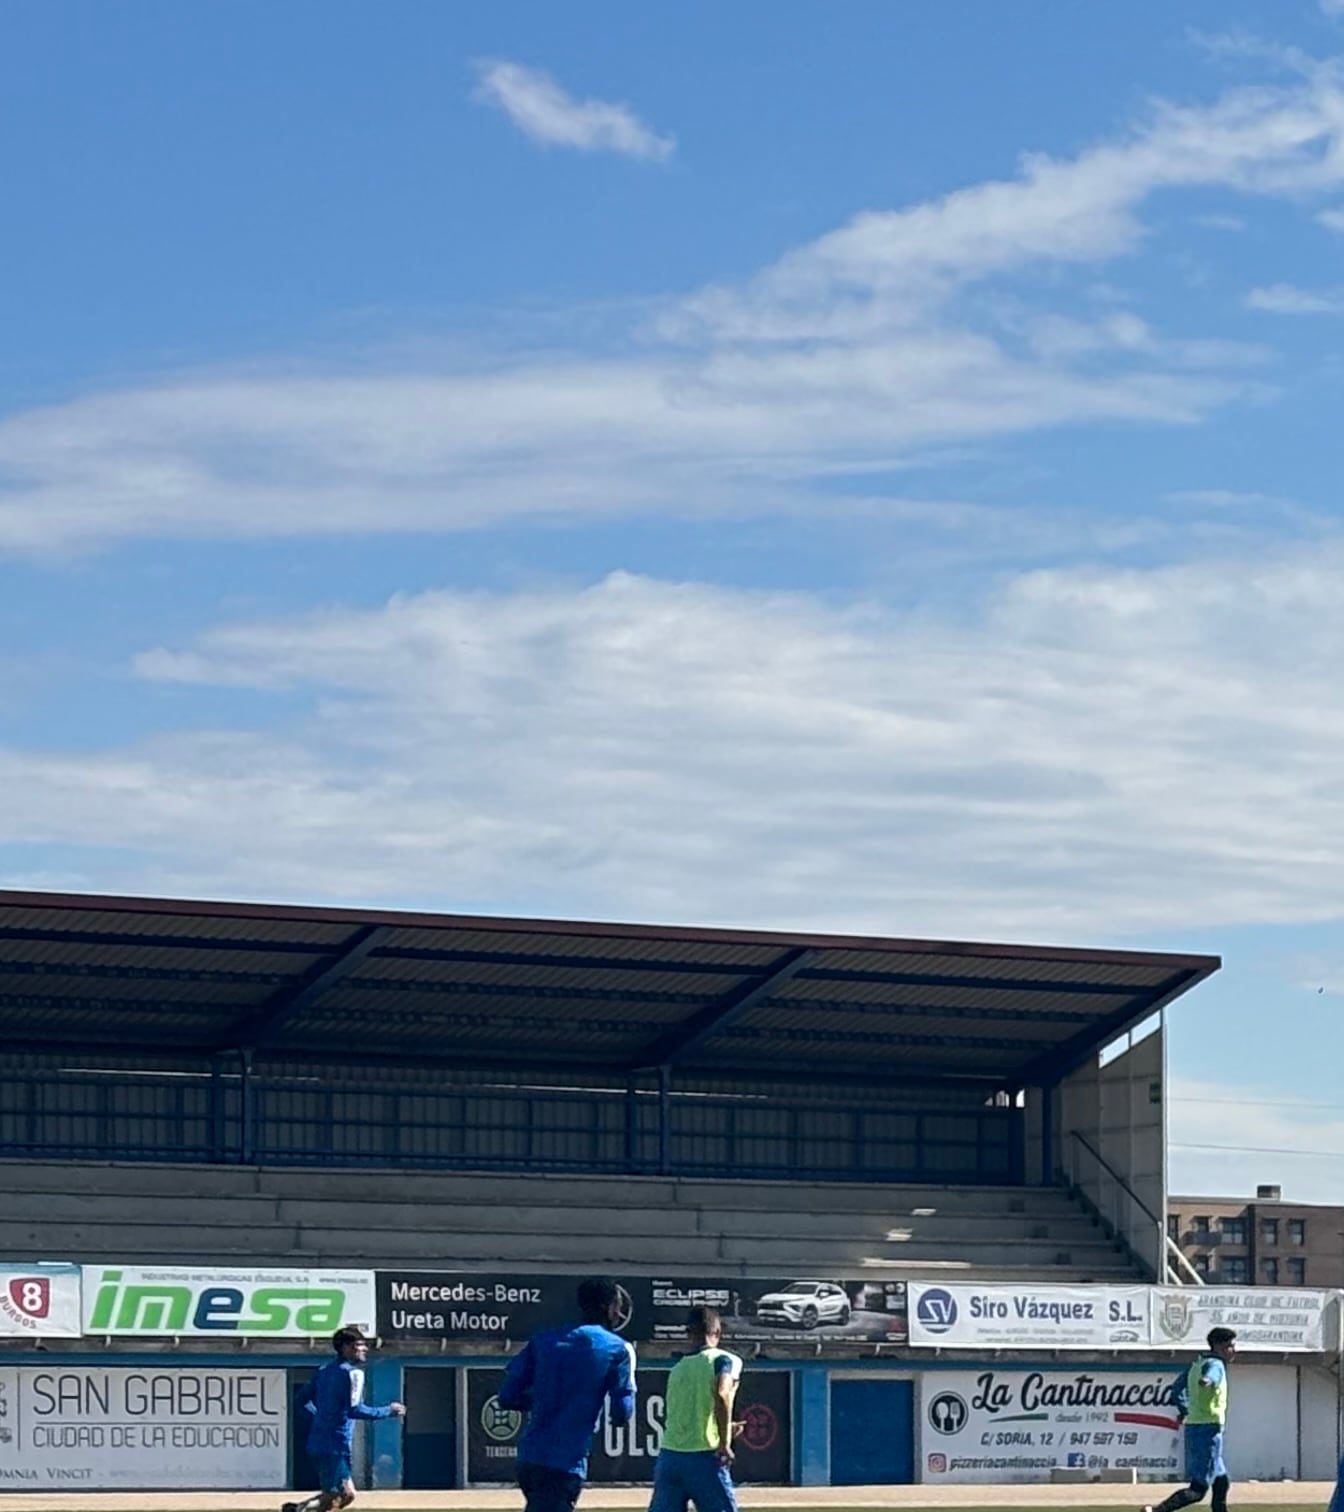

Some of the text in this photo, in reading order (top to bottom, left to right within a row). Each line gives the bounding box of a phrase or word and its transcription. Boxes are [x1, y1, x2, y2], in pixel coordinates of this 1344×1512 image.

[22, 1281, 43, 1312] 8
[90, 1270, 346, 1332] imesa
[391, 1281, 541, 1303] Mercedes-Benz
[653, 1288, 730, 1299] ECLIPSE
[392, 1310, 444, 1330] Ureta
[451, 1311, 509, 1331] Motor
[970, 1296, 1143, 1324] Siro Vázquez S.L.
[33, 1374, 279, 1416] SAN GABRIEL
[972, 1371, 1178, 1413] La Cantinaccia
[33, 1424, 280, 1449] CIUDAD DE LA EDUCACIÓN
[1039, 1432, 1054, 1446] 12
